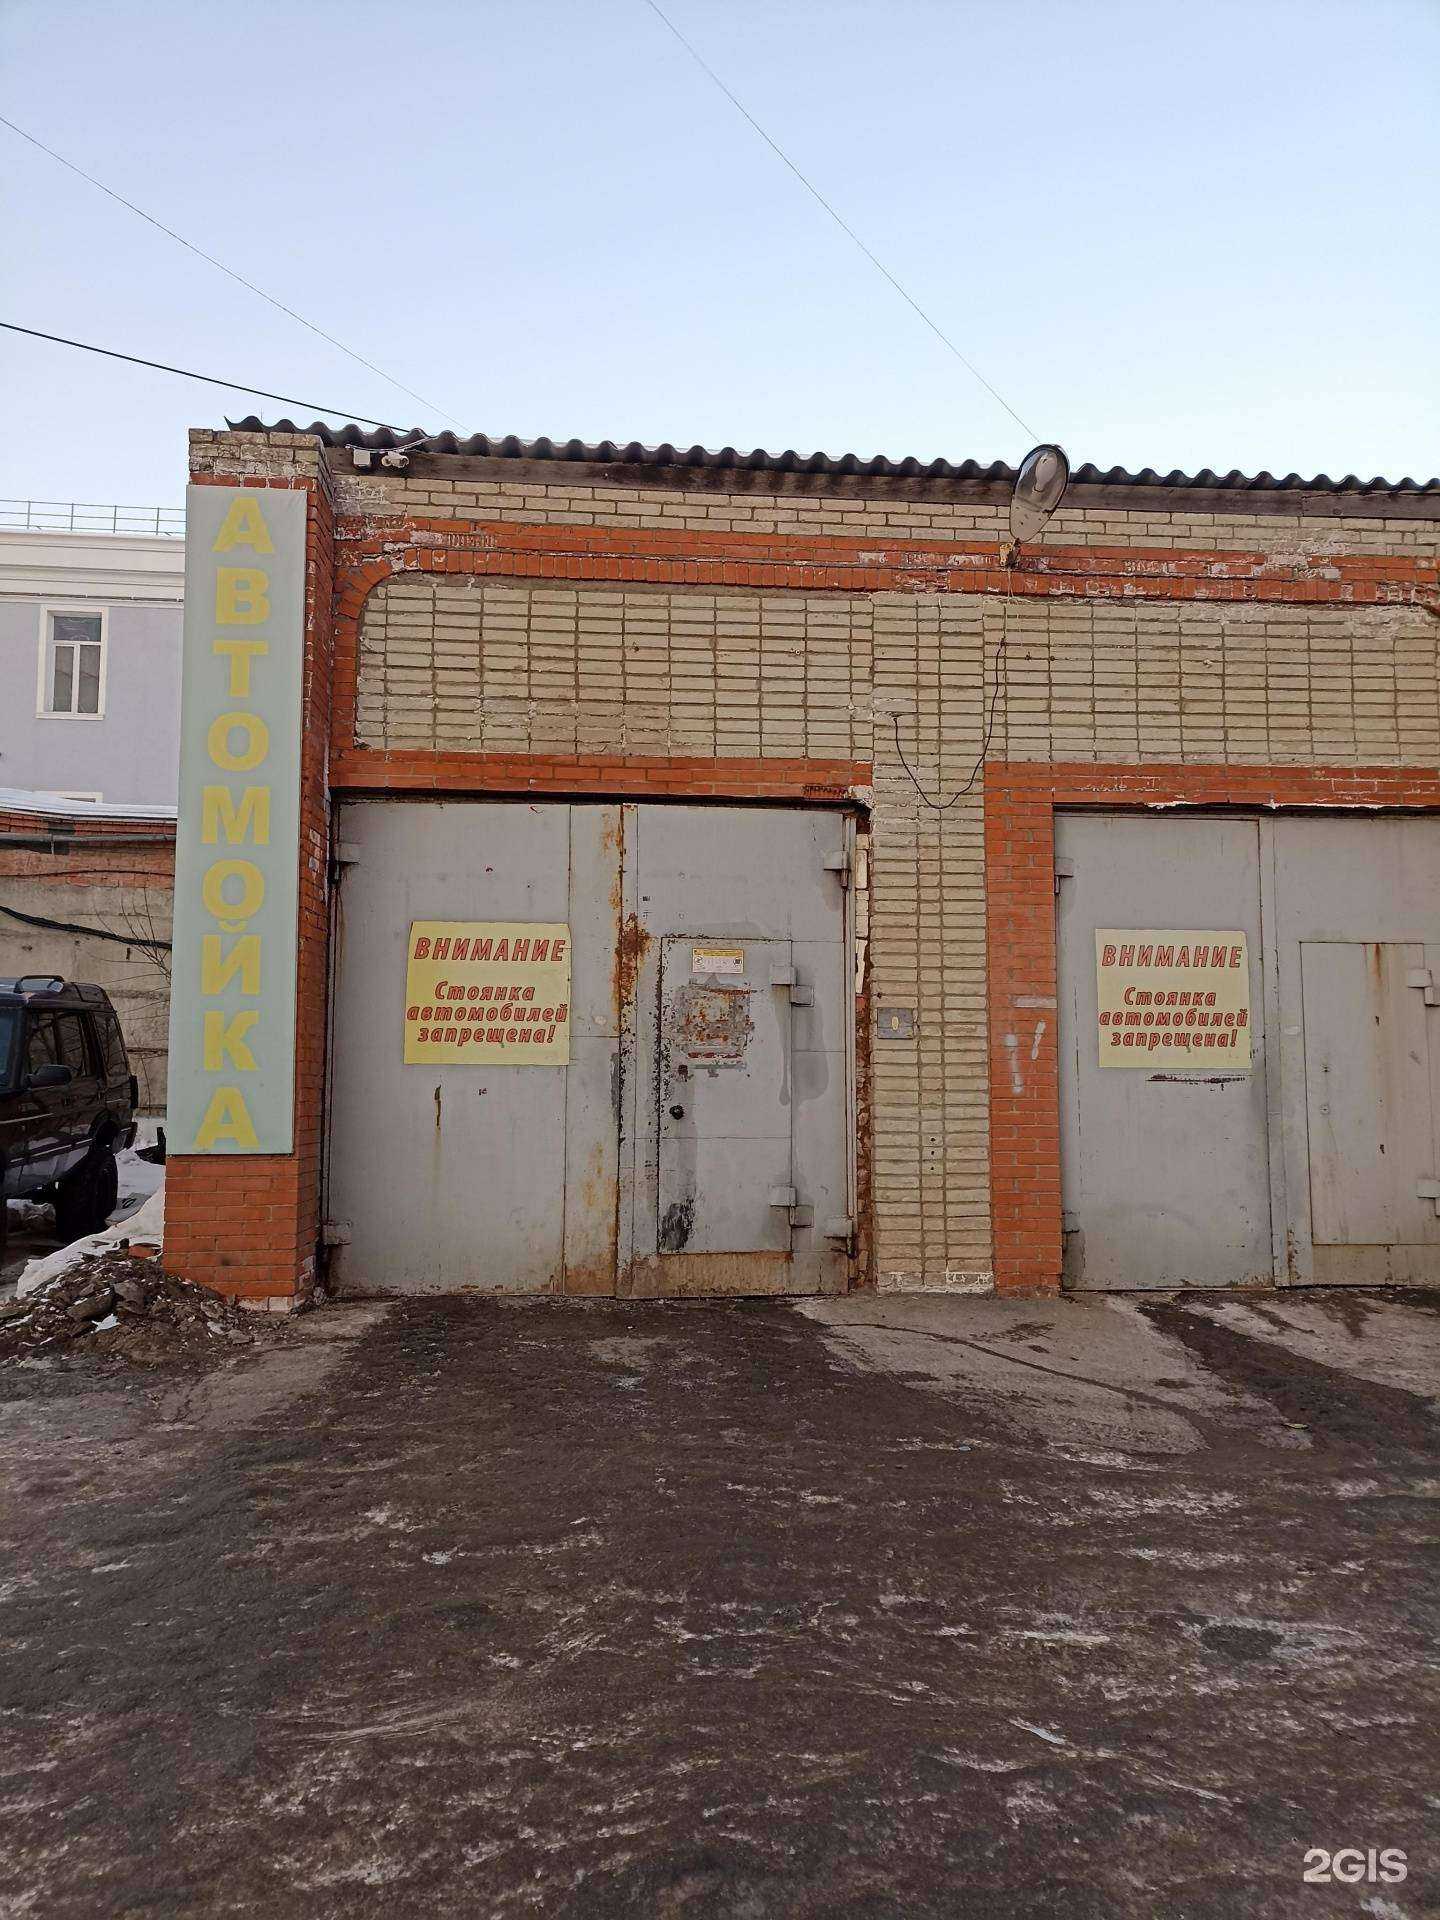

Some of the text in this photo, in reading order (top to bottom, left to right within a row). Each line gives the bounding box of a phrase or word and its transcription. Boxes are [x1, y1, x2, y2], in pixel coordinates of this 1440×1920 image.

[194, 496, 277, 1149] АВТОМОЙКА
[414, 937, 565, 961] ВНИМАНИЕ
[1102, 945, 1242, 968] ВНИМАНИЕ
[435, 980, 535, 1001] Стоянка
[1124, 987, 1216, 1006] Стоянка
[407, 1002, 568, 1023] автомобилей
[1100, 1008, 1248, 1027] автомобилей
[418, 1025, 556, 1047] запрещена!
[1111, 1029, 1238, 1052] запрещена!
